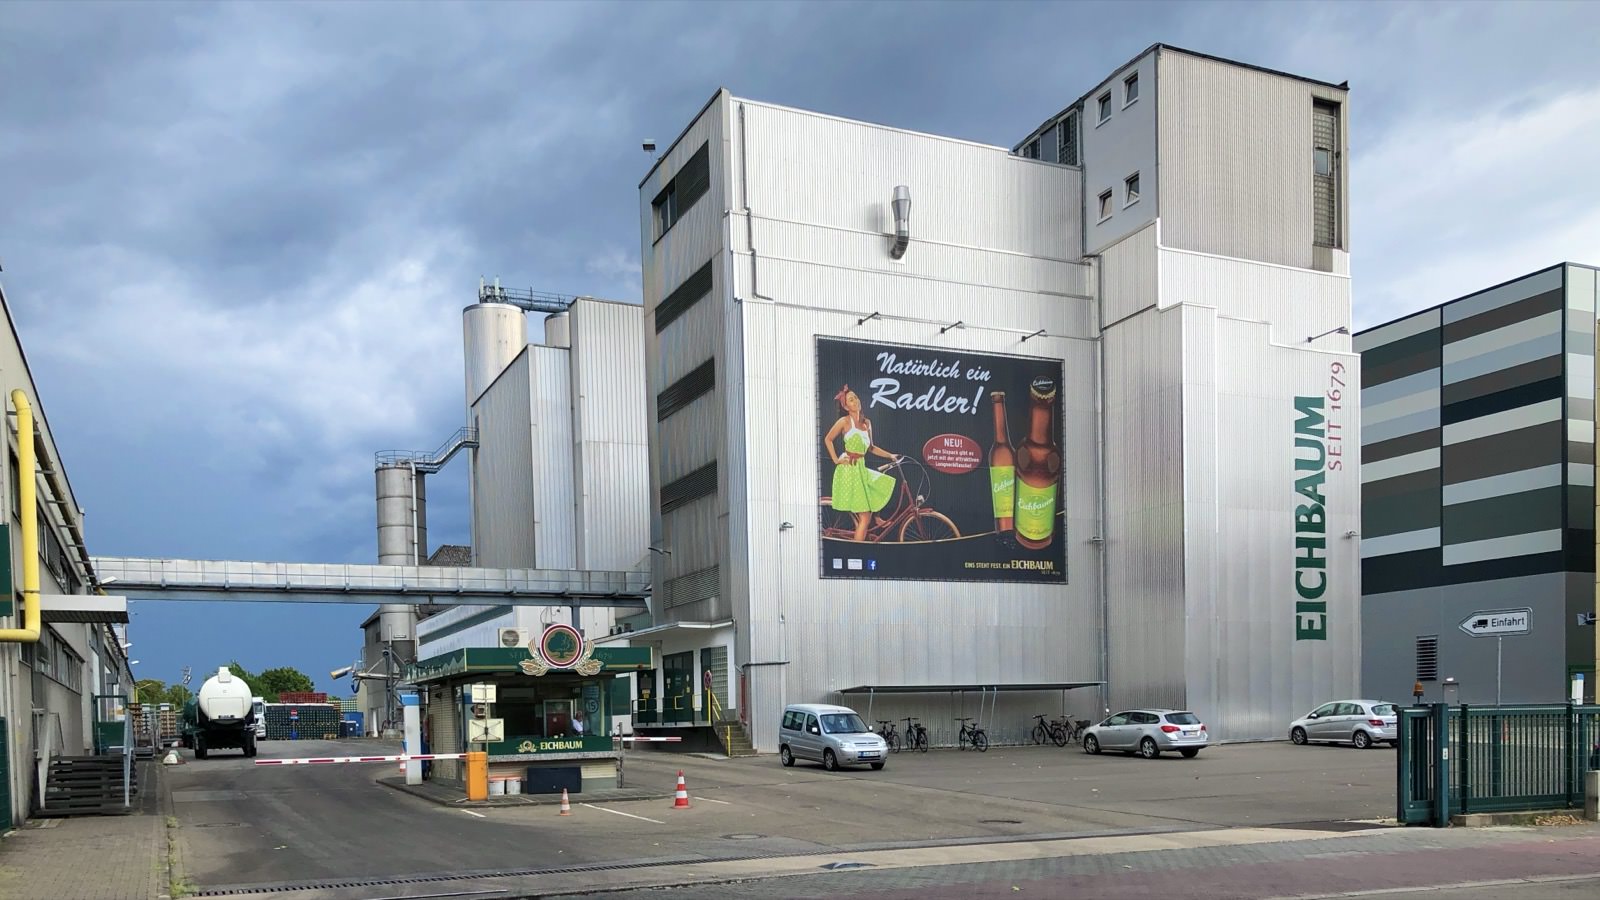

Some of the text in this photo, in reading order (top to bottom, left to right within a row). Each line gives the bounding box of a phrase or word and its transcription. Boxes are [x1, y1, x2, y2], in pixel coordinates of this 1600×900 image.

[876, 352, 992, 381] Natürlich ein
[870, 378, 984, 415] Radler!
[1326, 361, 1346, 471] SEIT 1679
[944, 438, 962, 448] NEU!
[1294, 396, 1326, 640] EICHBAUM
[1011, 560, 1053, 570] EICHBAUM
[1492, 617, 1524, 627] Einfahrt
[540, 740, 582, 750] EICHBAUM
